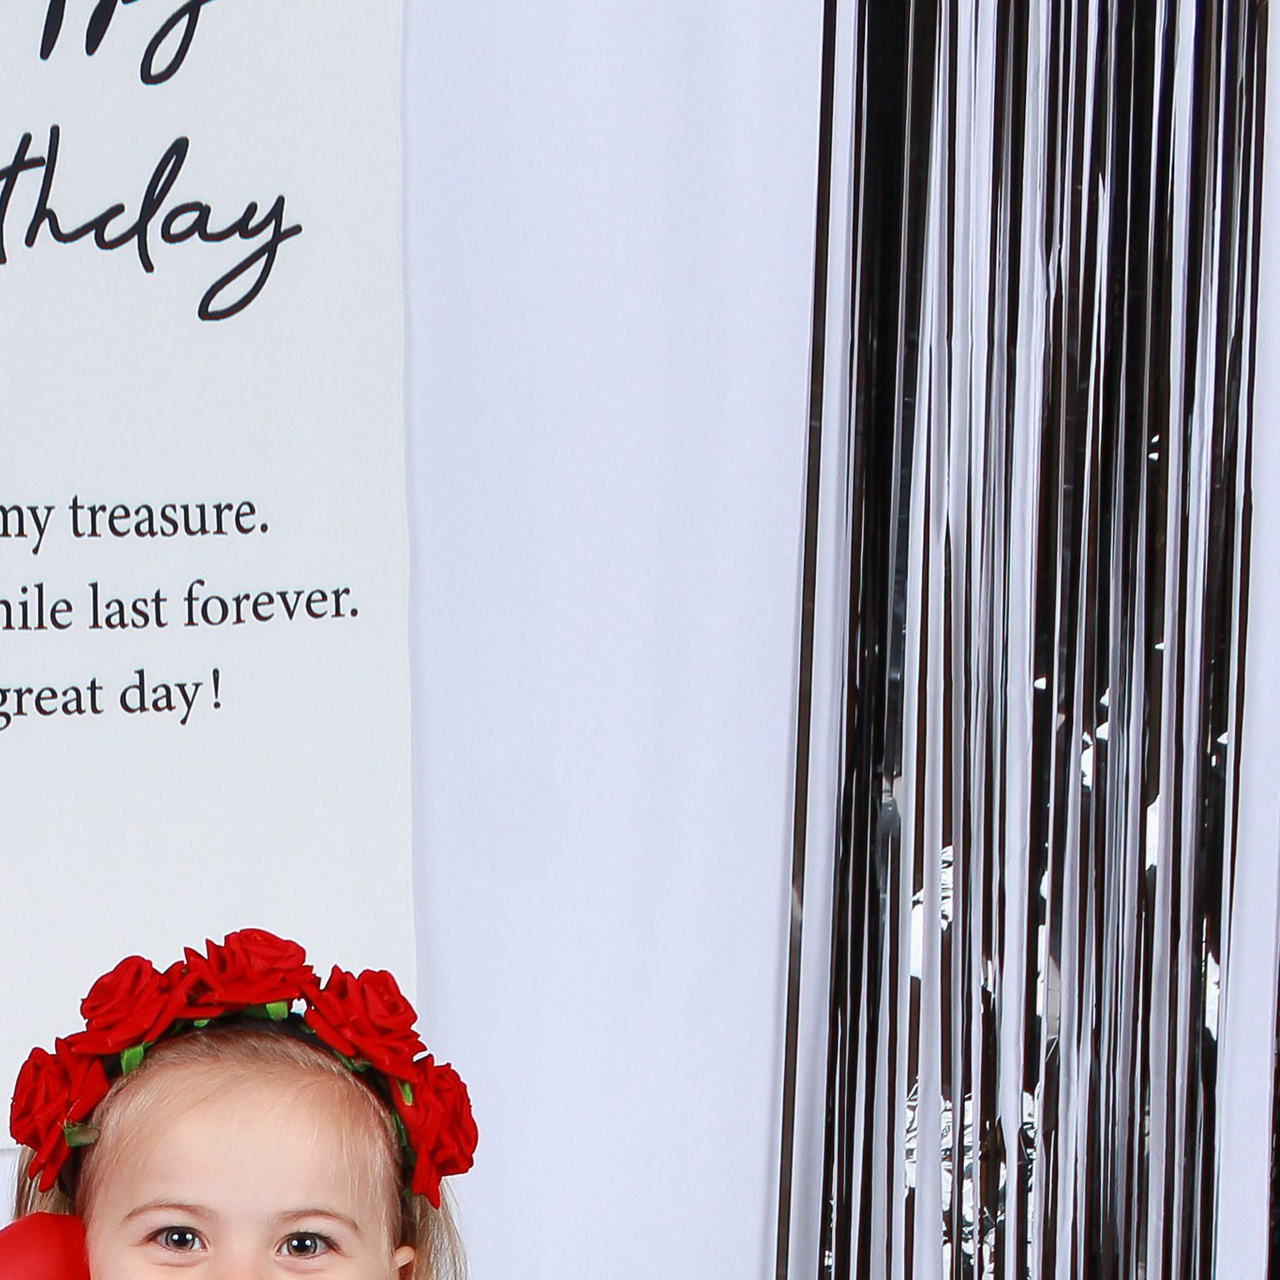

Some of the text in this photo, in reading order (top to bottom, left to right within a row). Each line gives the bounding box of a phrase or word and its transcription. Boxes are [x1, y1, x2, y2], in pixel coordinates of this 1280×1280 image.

[68, 494, 269, 538] treasure.
[88, 581, 168, 630] last
[183, 578, 359, 627] forever.
[119, 667, 221, 726] day!
